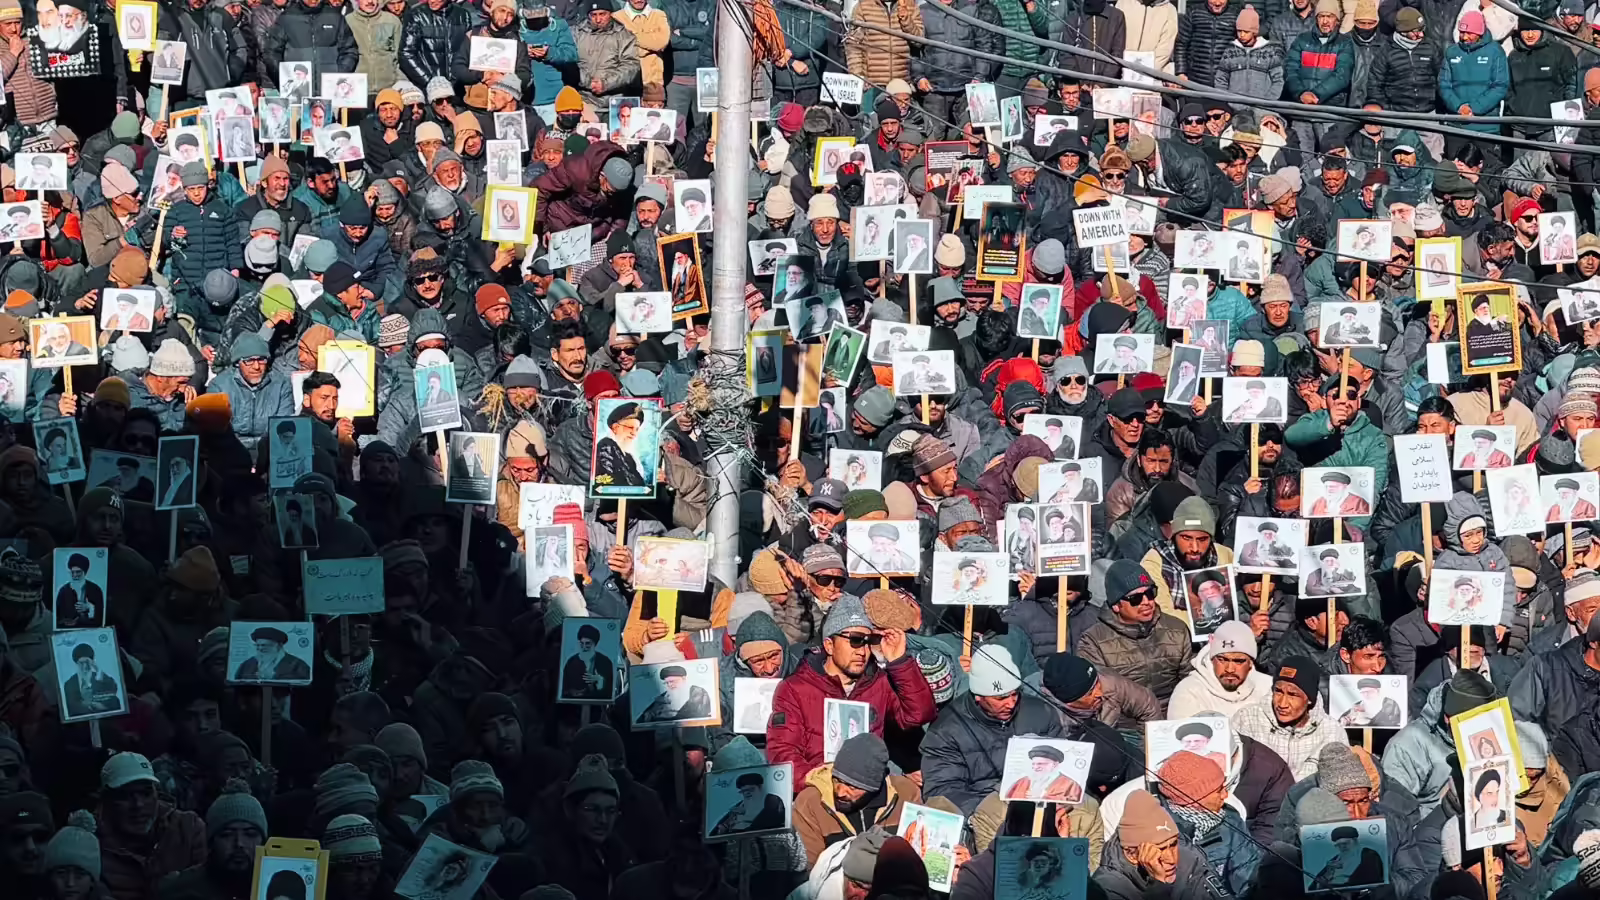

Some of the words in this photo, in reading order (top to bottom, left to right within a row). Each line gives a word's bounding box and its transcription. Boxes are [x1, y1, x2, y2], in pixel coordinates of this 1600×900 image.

[825, 76, 843, 86] DOWN
[843, 79, 859, 88] WITH
[1078, 211, 1101, 224] DOWN
[1101, 208, 1122, 221] WITH
[1081, 223, 1126, 241] AMERICA
